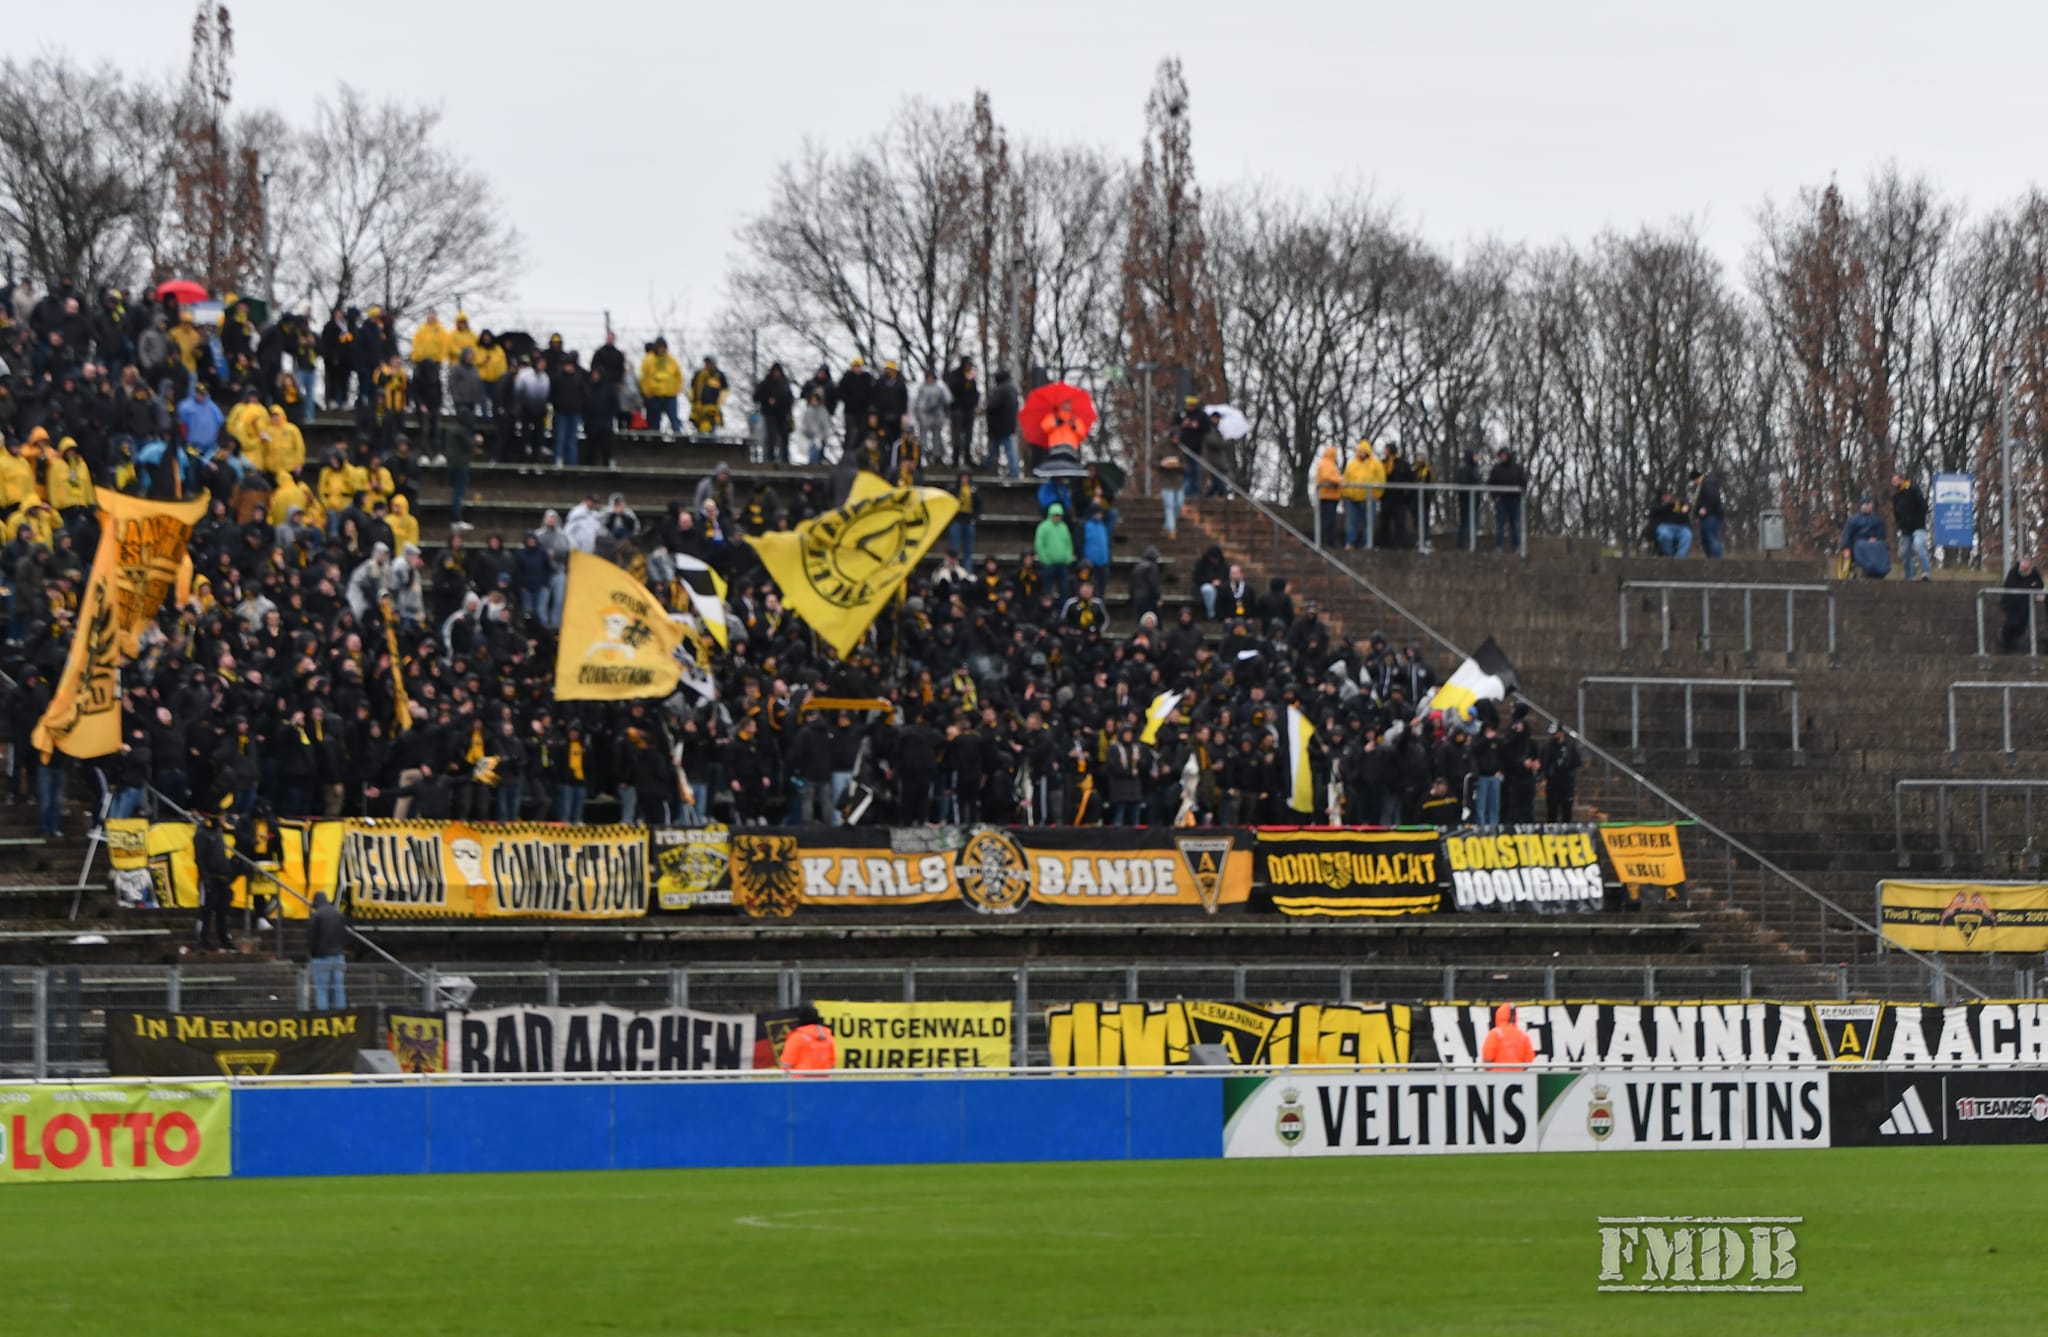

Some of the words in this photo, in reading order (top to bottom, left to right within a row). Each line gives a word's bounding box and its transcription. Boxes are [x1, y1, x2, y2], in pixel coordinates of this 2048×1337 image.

[345, 831, 445, 905] YELLOW
[493, 840, 646, 913] CONNECTION
[1267, 852, 1323, 886] DOM
[1351, 852, 1436, 886] WACHT
[1446, 832, 1598, 871] BOXSTAFFEL
[801, 856, 949, 897] KARLS
[1036, 855, 1179, 897] BANDE
[1452, 863, 1604, 907] HOOLIGANS
[1884, 909, 1909, 921] Tivoli
[1911, 910, 1941, 924] Tigers
[1996, 911, 2024, 923] Since
[132, 1013, 169, 1041] IN
[174, 1014, 358, 1043] MEMORIAM
[821, 1012, 1007, 1039] HÜRTGENWALD
[1191, 1002, 1265, 1033] ALEMANNIA
[1887, 1003, 2048, 1063] AACH
[461, 1012, 554, 1073] BAD
[564, 1012, 743, 1073] AACHEN
[1316, 1083, 1527, 1147] VELTINS
[1625, 1081, 1823, 1142] VELTINS
[12, 1110, 202, 1170] LOTTO
